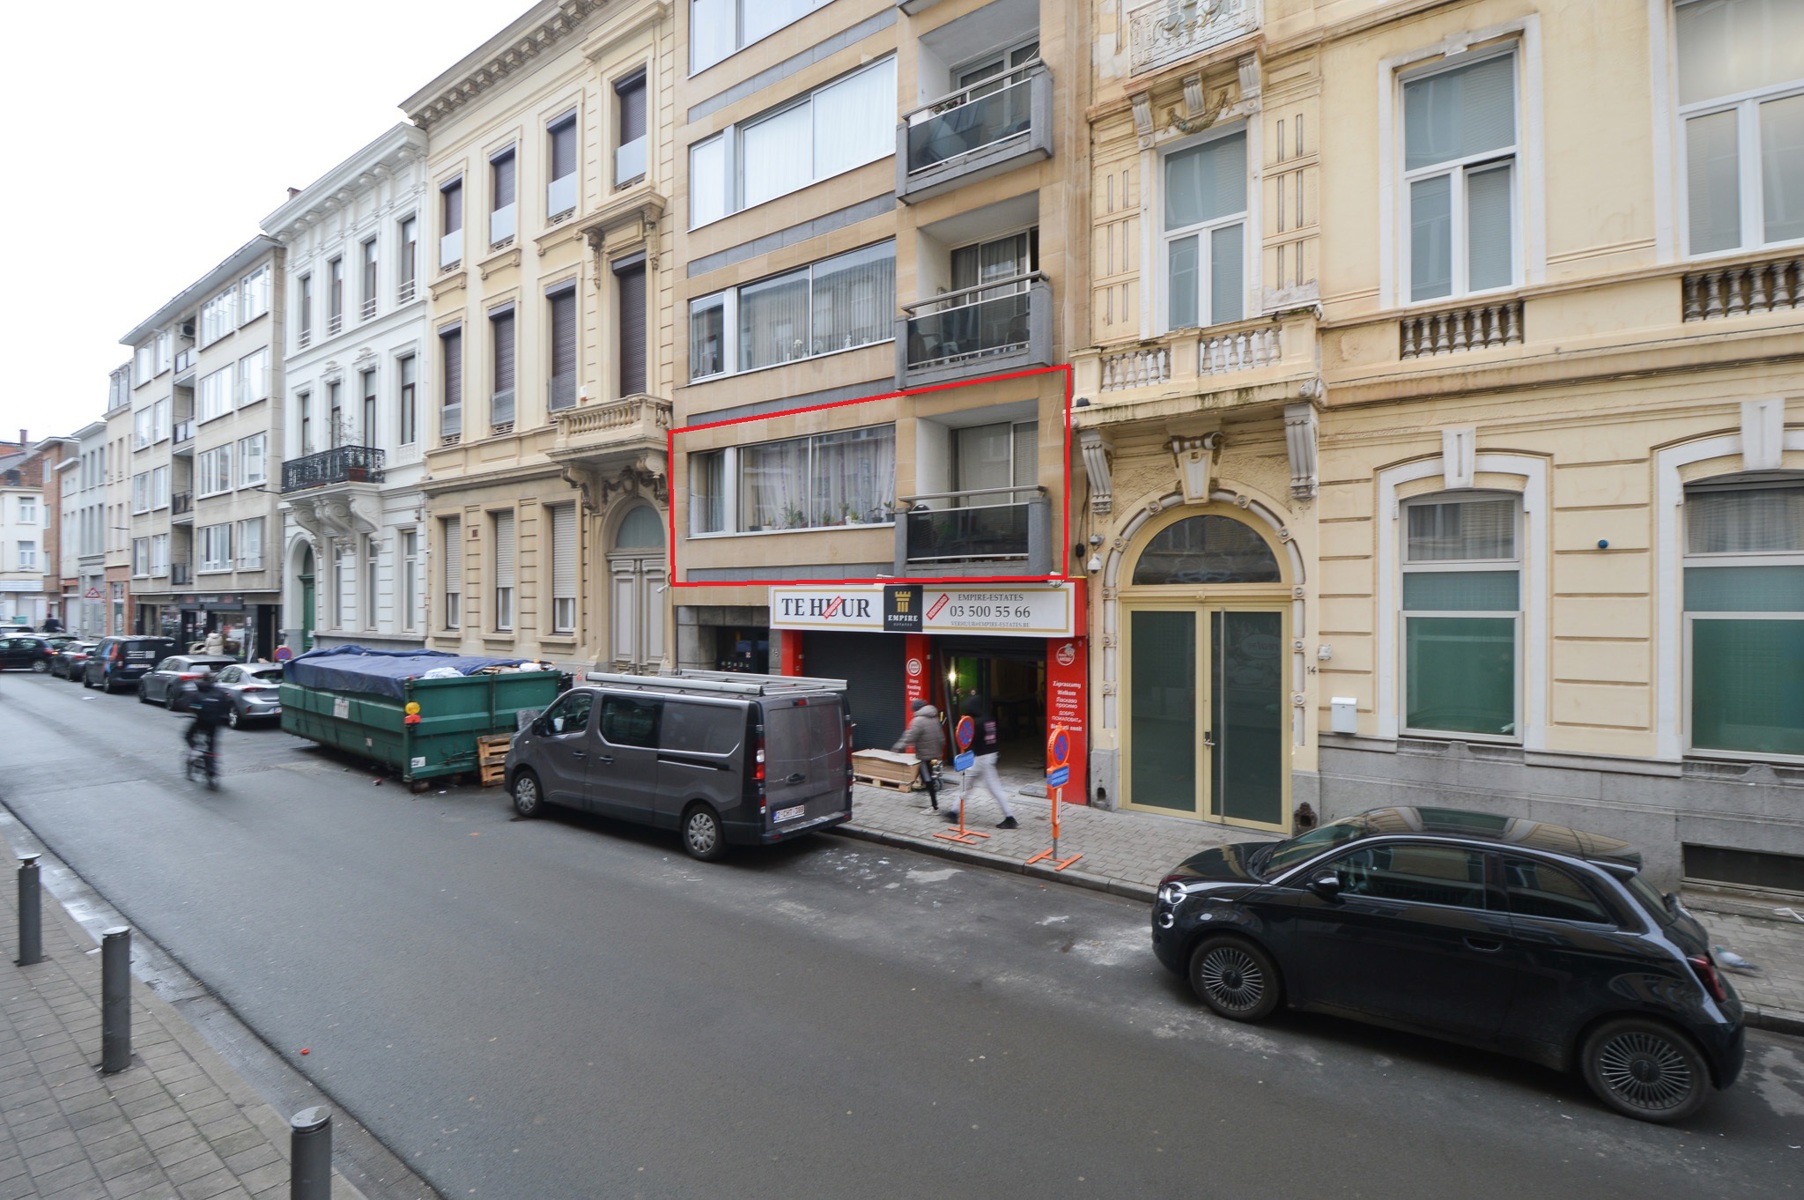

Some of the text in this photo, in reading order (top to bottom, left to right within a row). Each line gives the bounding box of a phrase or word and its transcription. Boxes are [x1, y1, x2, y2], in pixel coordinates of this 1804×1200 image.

[958, 593, 1024, 602] EMPIRE-ESTATES
[781, 598, 871, 618] TE HUUR
[950, 605, 1031, 618] 03 500 55 66
[887, 614, 919, 622] EMPIRE
[1306, 665, 1317, 675] 14
